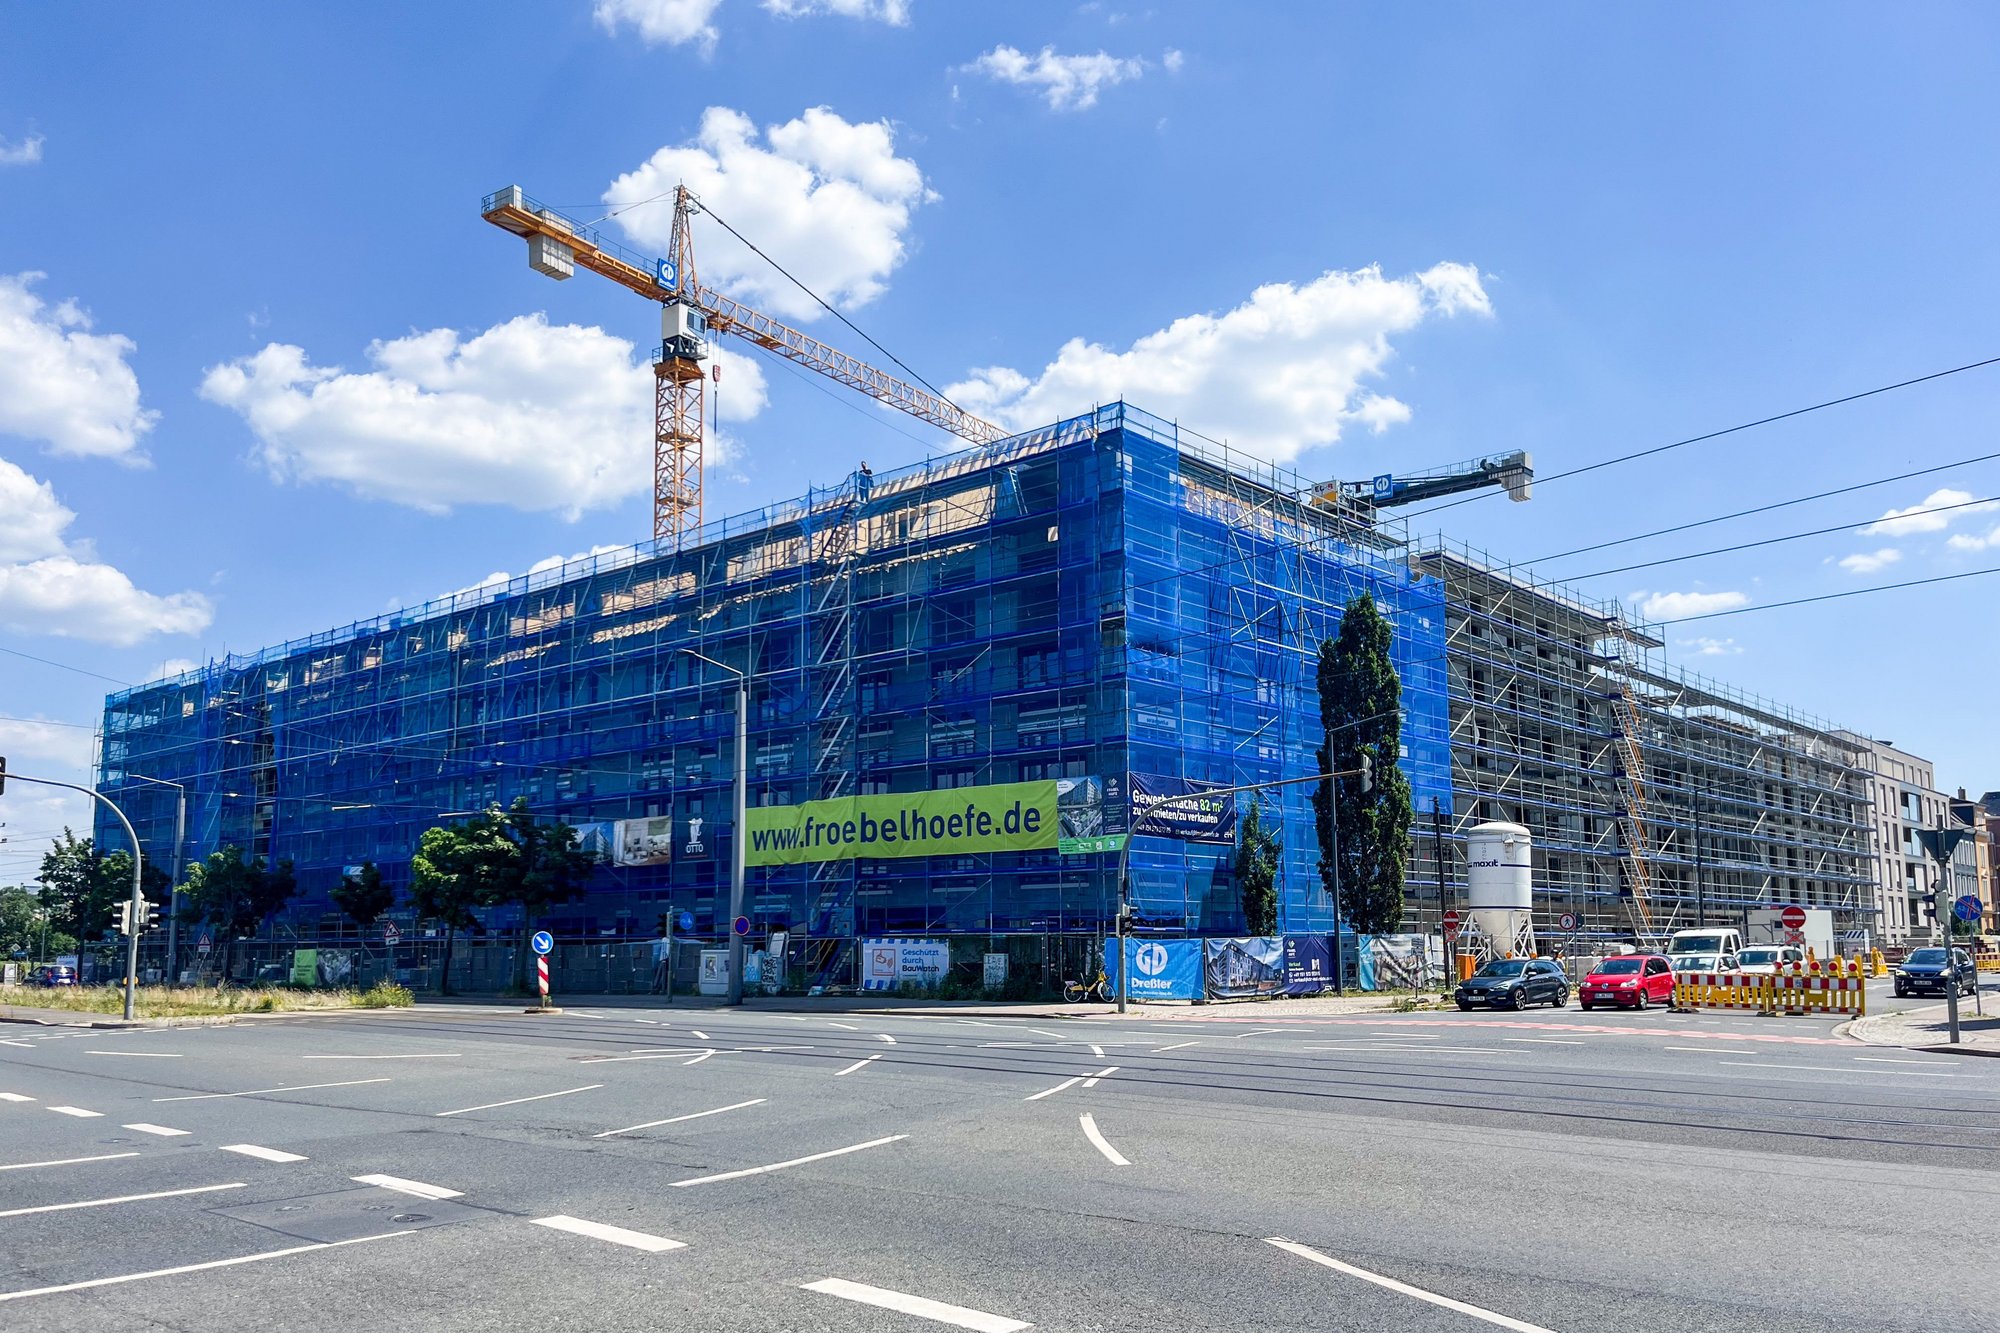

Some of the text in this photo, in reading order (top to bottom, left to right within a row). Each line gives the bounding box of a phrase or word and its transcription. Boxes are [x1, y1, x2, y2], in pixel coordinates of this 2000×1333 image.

[1199, 799, 1211, 812] 82
[1212, 800, 1224, 813] m²
[1132, 807, 1142, 816] zu
[1141, 808, 1187, 821] vmieten/zu
[1187, 813, 1218, 824] verkaufen
[751, 801, 1041, 852] www.froebelhoefe.de
[686, 844, 704, 853] OTTO
[1472, 859, 1499, 868] maxit
[902, 948, 940, 956] Geschützt
[1135, 942, 1168, 976] GD
[1131, 977, 1172, 989] Dreßler
